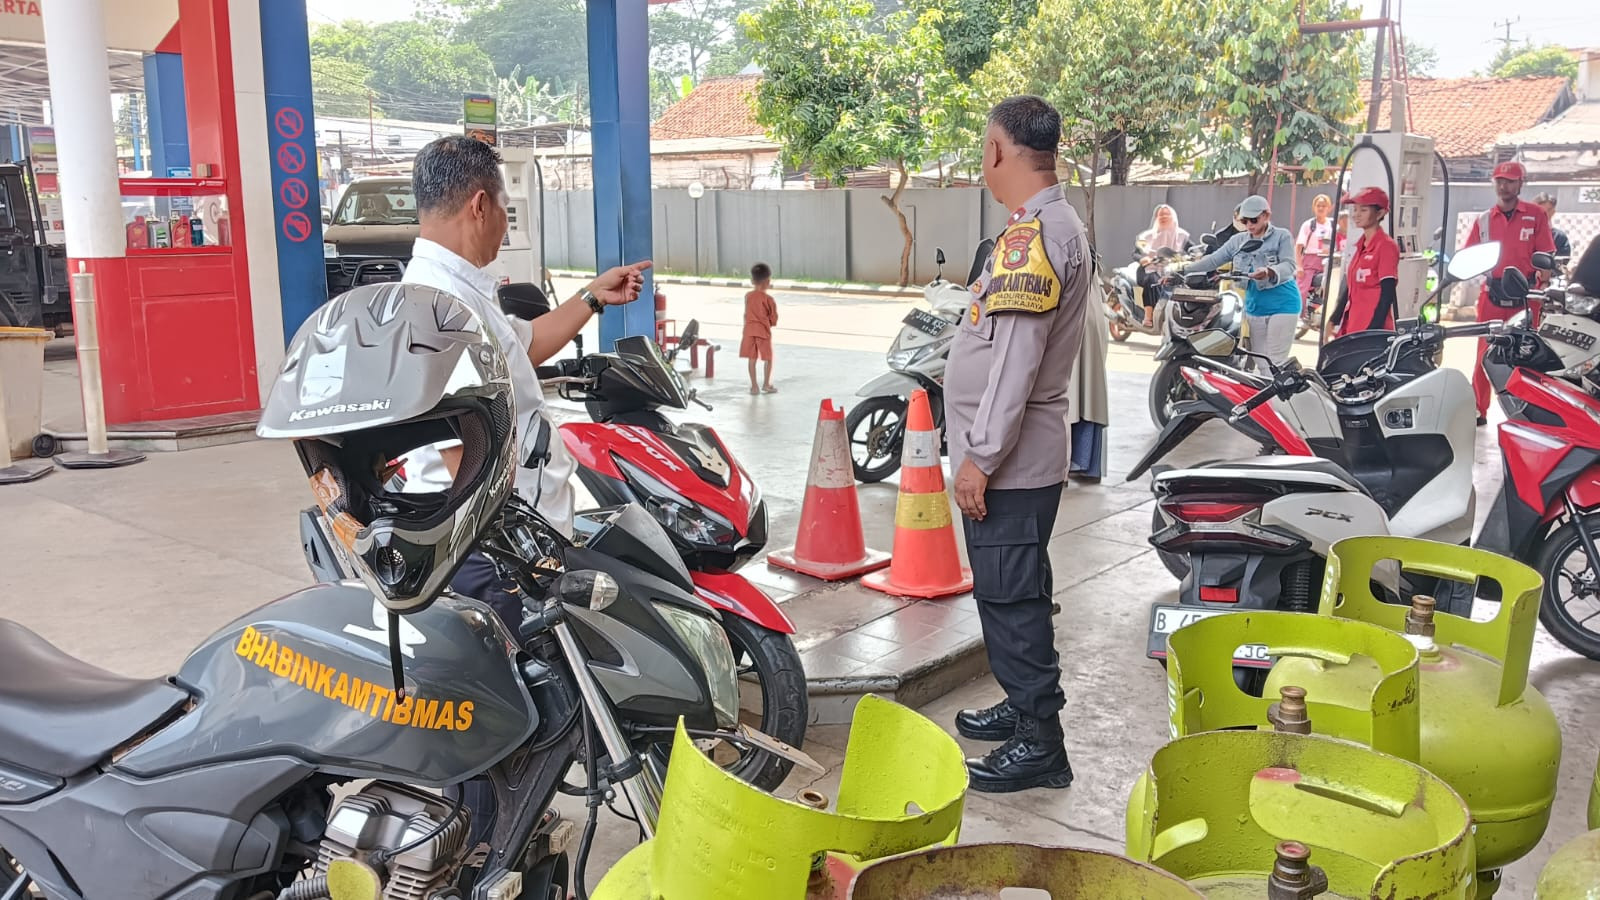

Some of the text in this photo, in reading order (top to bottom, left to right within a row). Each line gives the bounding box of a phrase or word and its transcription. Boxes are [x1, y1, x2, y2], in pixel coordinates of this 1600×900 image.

[288, 398, 393, 423] Kawasaki
[1304, 507, 1354, 523] PCX
[1156, 612, 1167, 631] B
[235, 625, 474, 732] BHABINKAMTIBMAS
